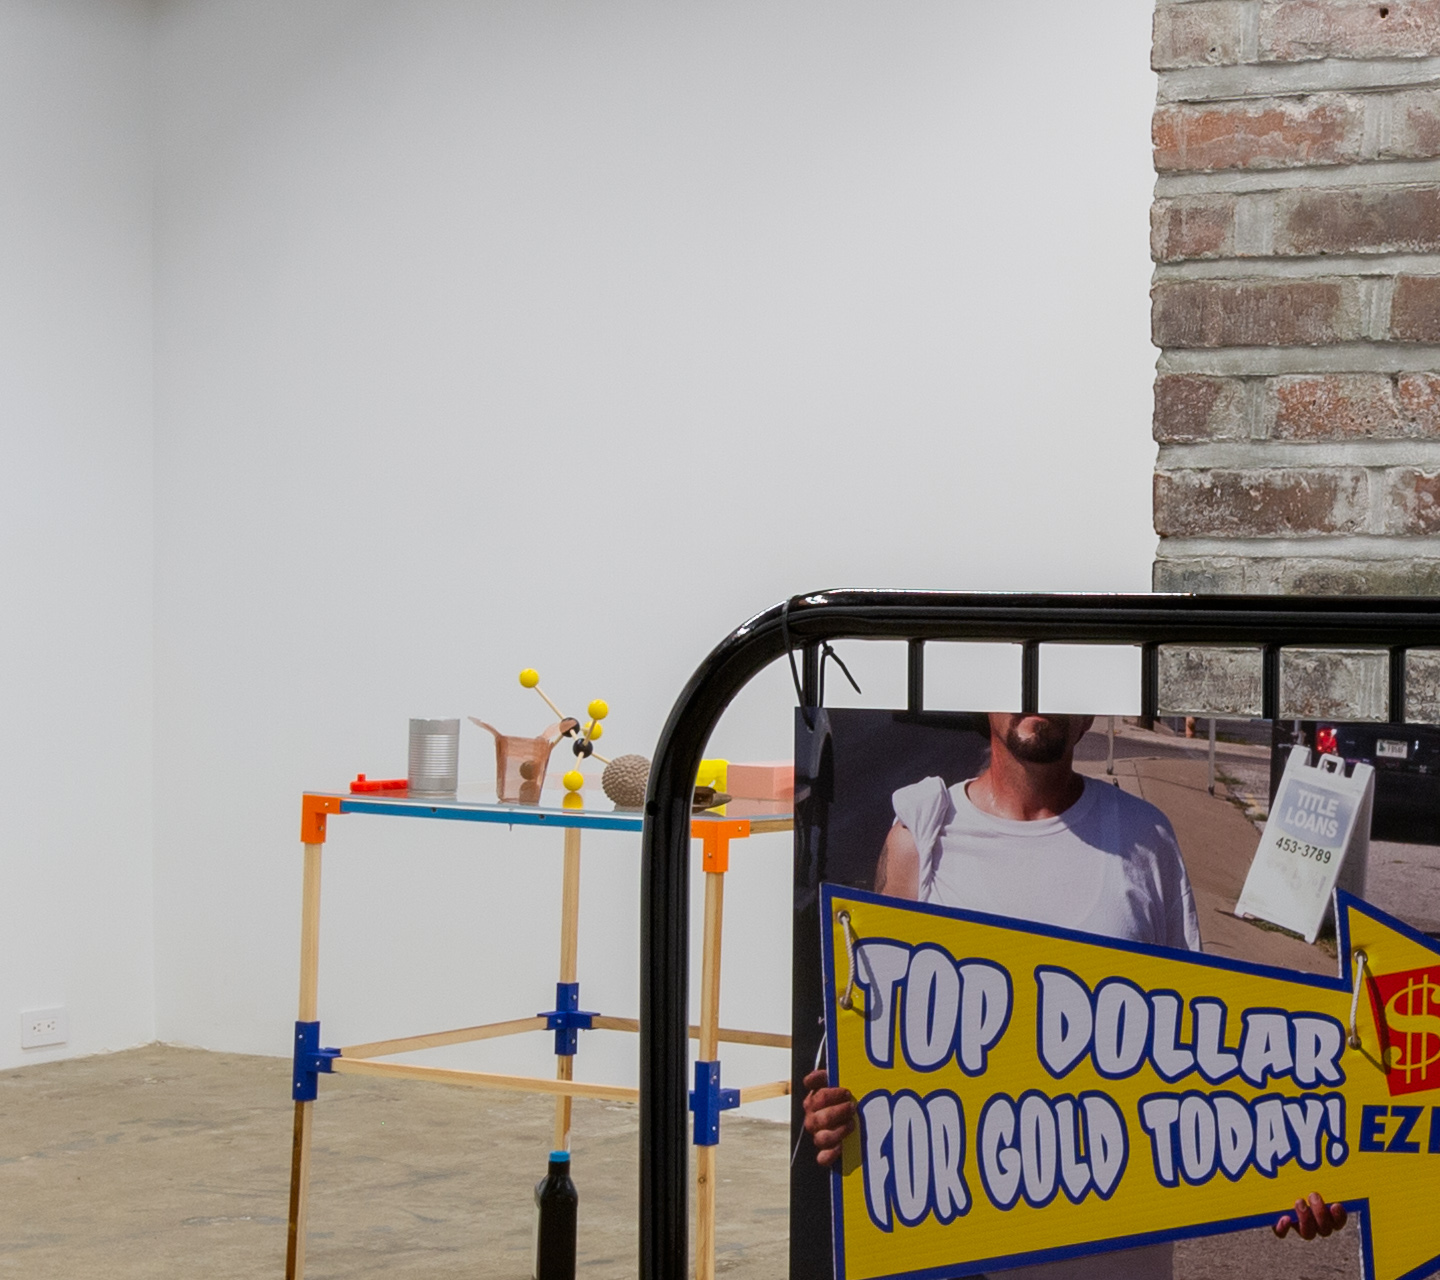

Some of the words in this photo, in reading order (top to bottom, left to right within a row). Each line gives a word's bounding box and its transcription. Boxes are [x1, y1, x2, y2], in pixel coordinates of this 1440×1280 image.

[1298, 789, 1339, 818] TITLE
[1284, 806, 1339, 838] LOANS
[1275, 837, 1332, 864] 453-3789
[854, 938, 1013, 1077] TOP
[1034, 965, 1347, 1089] DOLLAR
[860, 1089, 972, 1232] FOR
[977, 1089, 1129, 1211] GOLD
[1138, 1091, 1349, 1187] TODAY!
